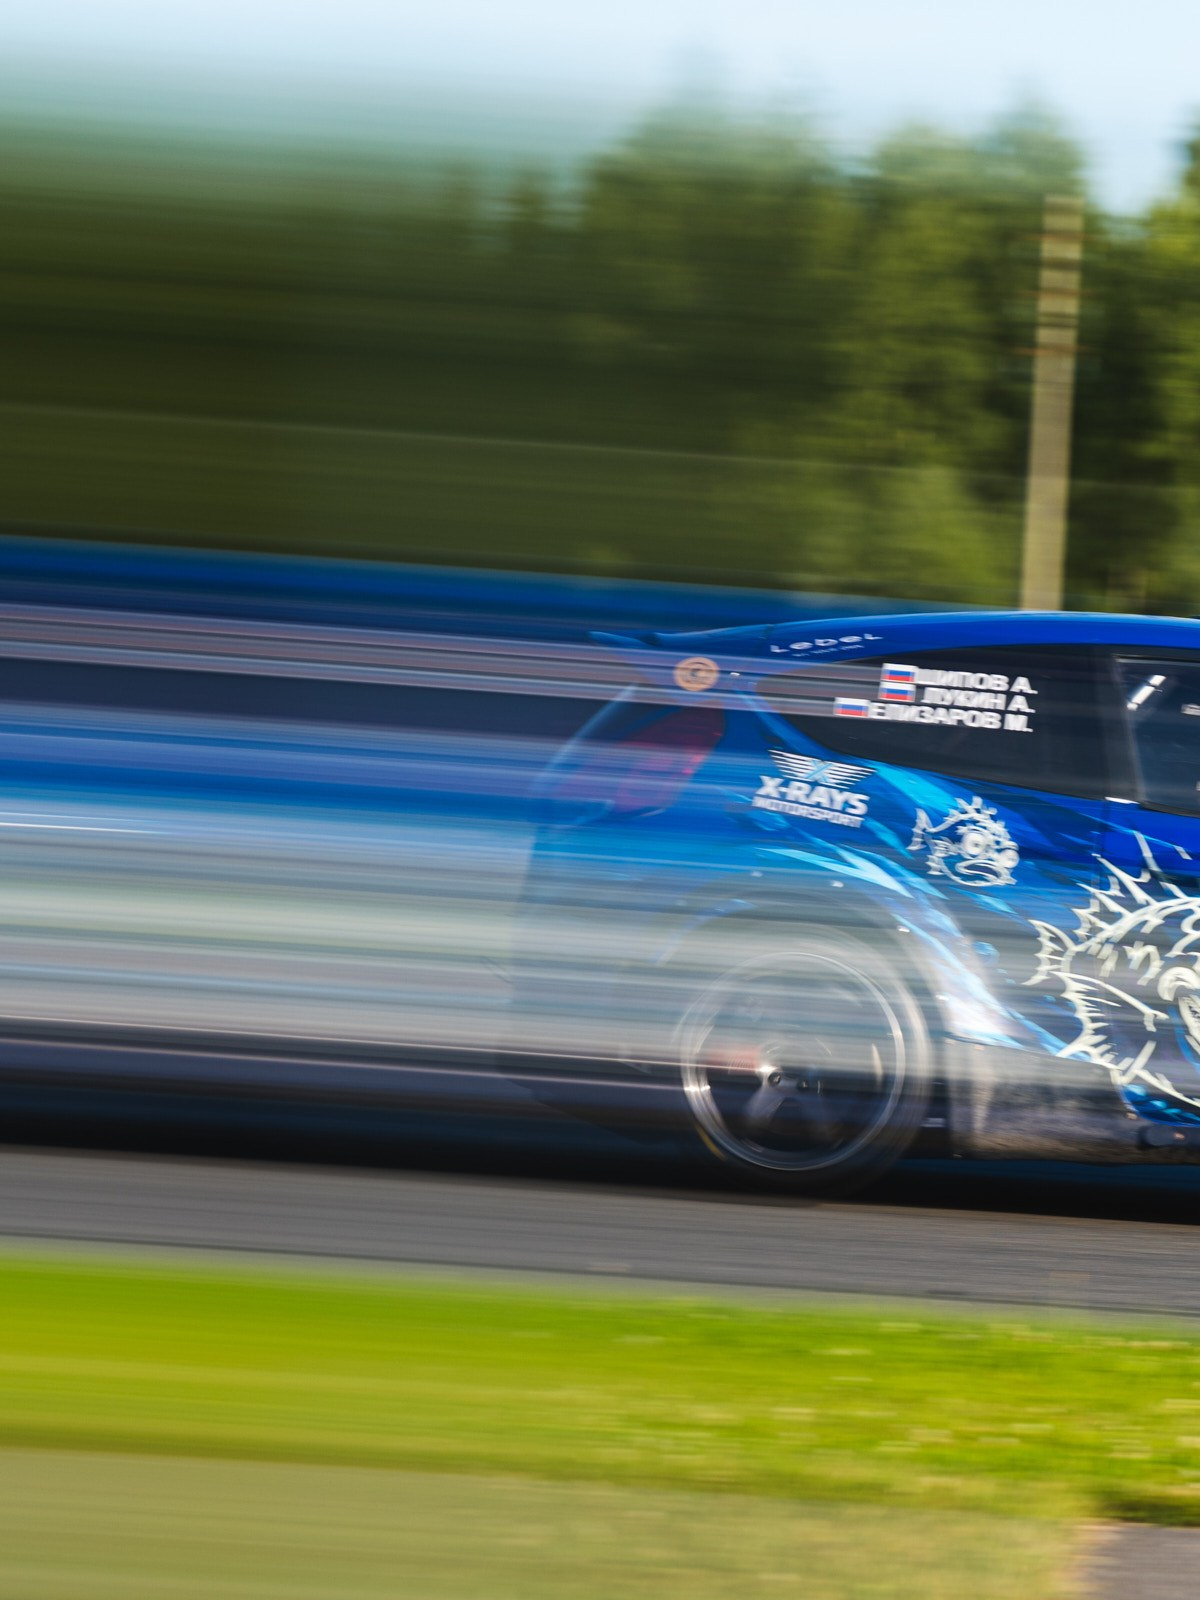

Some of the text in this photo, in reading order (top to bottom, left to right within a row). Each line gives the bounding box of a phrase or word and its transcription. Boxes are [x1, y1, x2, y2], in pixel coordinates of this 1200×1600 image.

[916, 667, 1039, 694] ШИПОВ А.
[921, 686, 1036, 713] ЛУКИН А.
[869, 702, 1034, 733] ЕЛИЗАРОВ М.
[755, 775, 870, 815] X-RAYS
